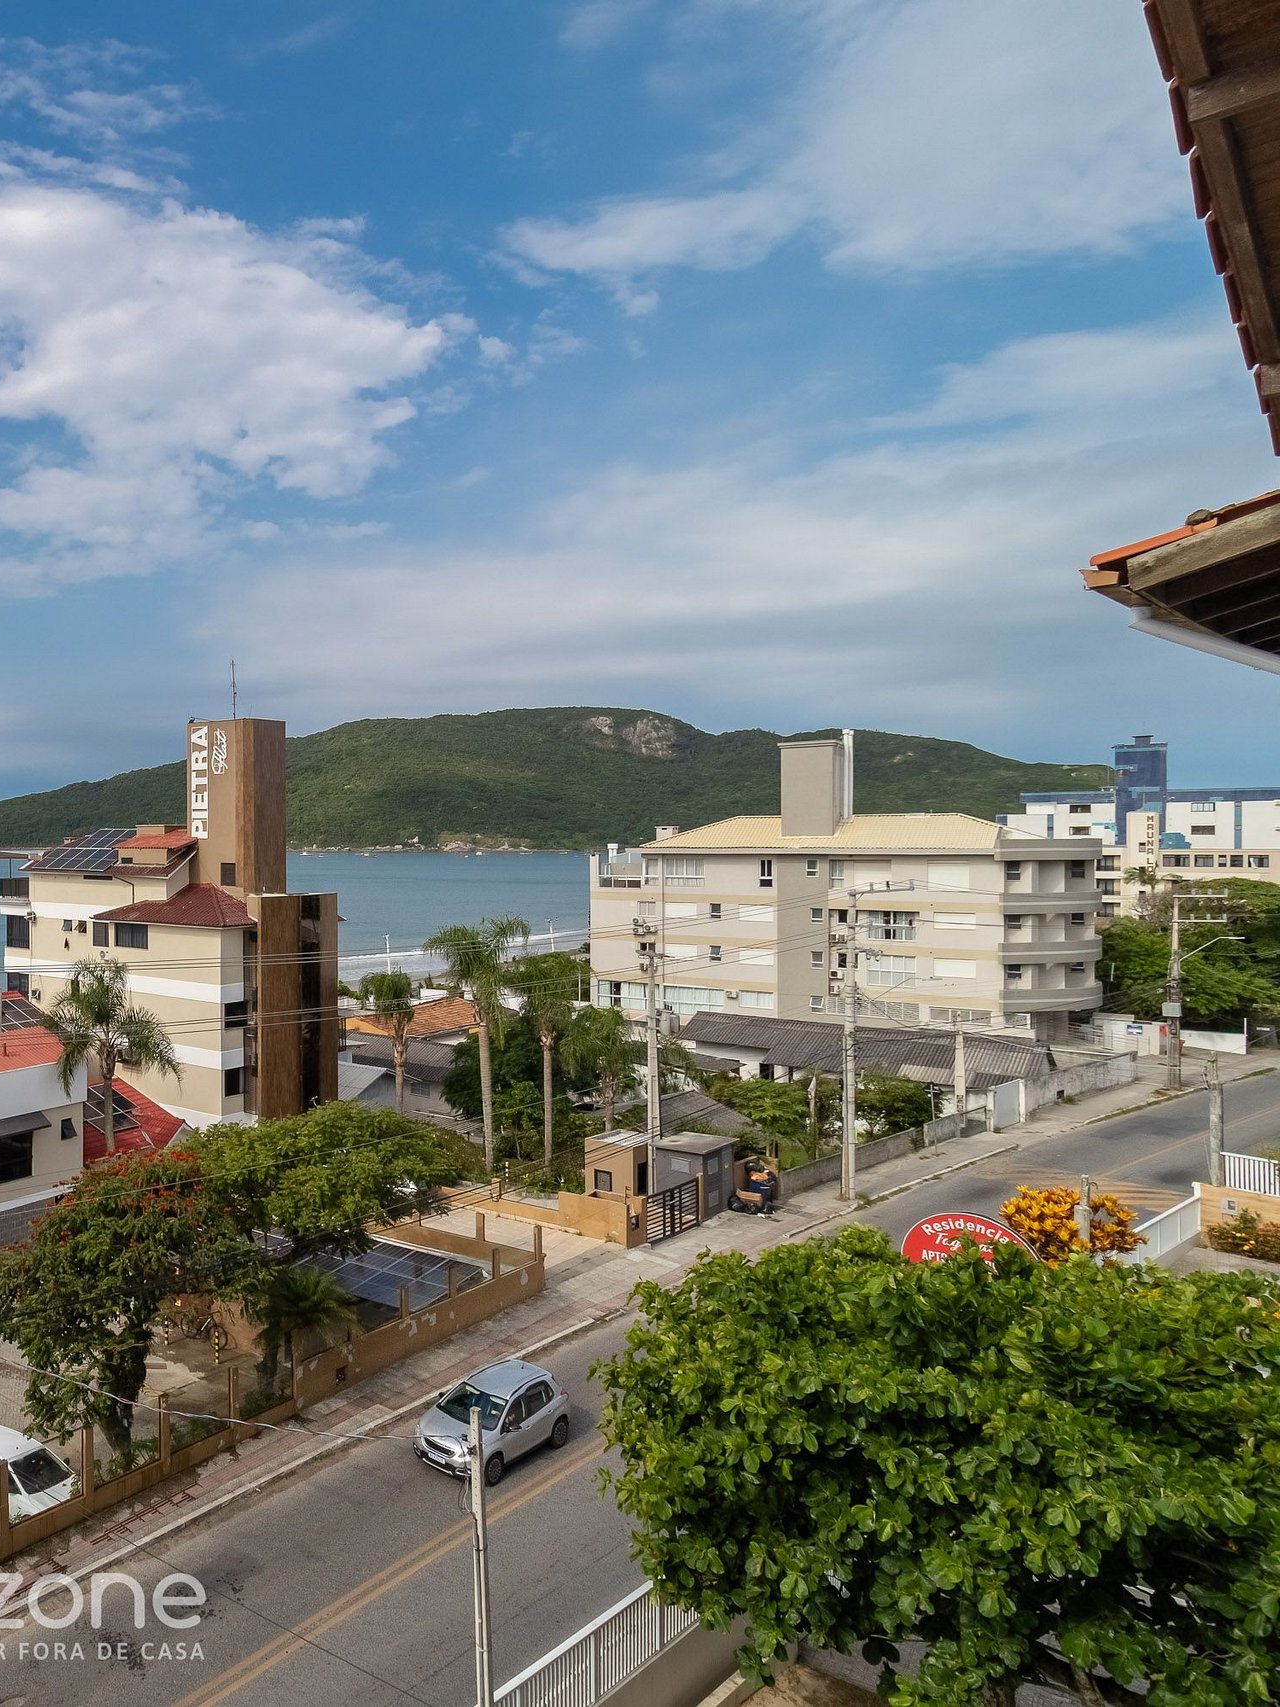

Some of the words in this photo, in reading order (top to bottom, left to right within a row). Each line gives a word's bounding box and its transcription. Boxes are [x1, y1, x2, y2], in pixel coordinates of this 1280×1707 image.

[212, 728, 228, 774] Flat
[191, 725, 208, 839] PIETRA
[1146, 815, 1154, 855] MAUNA
[921, 1218, 1018, 1245] Residencia
